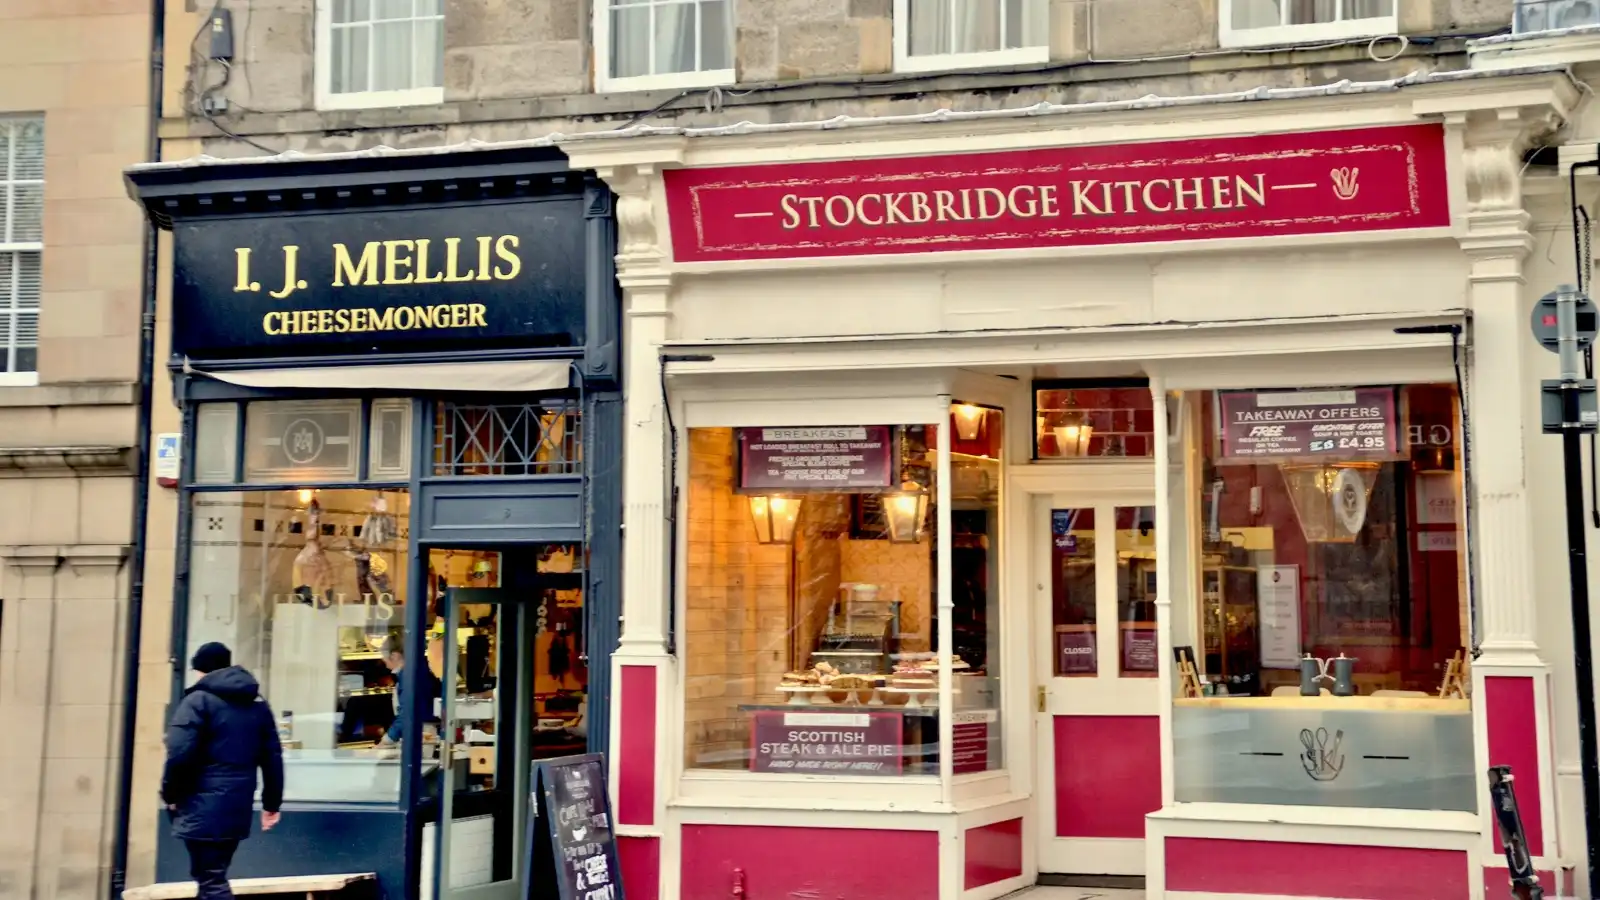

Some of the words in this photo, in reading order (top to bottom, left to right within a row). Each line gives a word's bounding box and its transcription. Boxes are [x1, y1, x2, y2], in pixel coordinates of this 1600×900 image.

[780, 184, 1061, 229] STOCKBRIDGE
[1068, 173, 1266, 216] KITCHEN
[233, 247, 261, 292] I.
[269, 245, 308, 298] J.
[331, 234, 522, 287] MELLIS
[263, 303, 488, 336] CHEESEMONGER
[1235, 410, 1315, 421] TAKEAWAY
[1319, 407, 1381, 419] OFFERS
[774, 429, 853, 439] BREAKFAST
[1249, 425, 1286, 437] FREE
[1339, 437, 1385, 448] £4.95
[1064, 647, 1092, 655] CLOSED
[788, 731, 865, 743] SCOTTISH
[760, 743, 811, 754] STEAK
[815, 744, 826, 755] &
[832, 744, 862, 755] ALE
[867, 745, 893, 756] PIE
[768, 760, 795, 769] HAND
[822, 761, 850, 769] RIGHT
